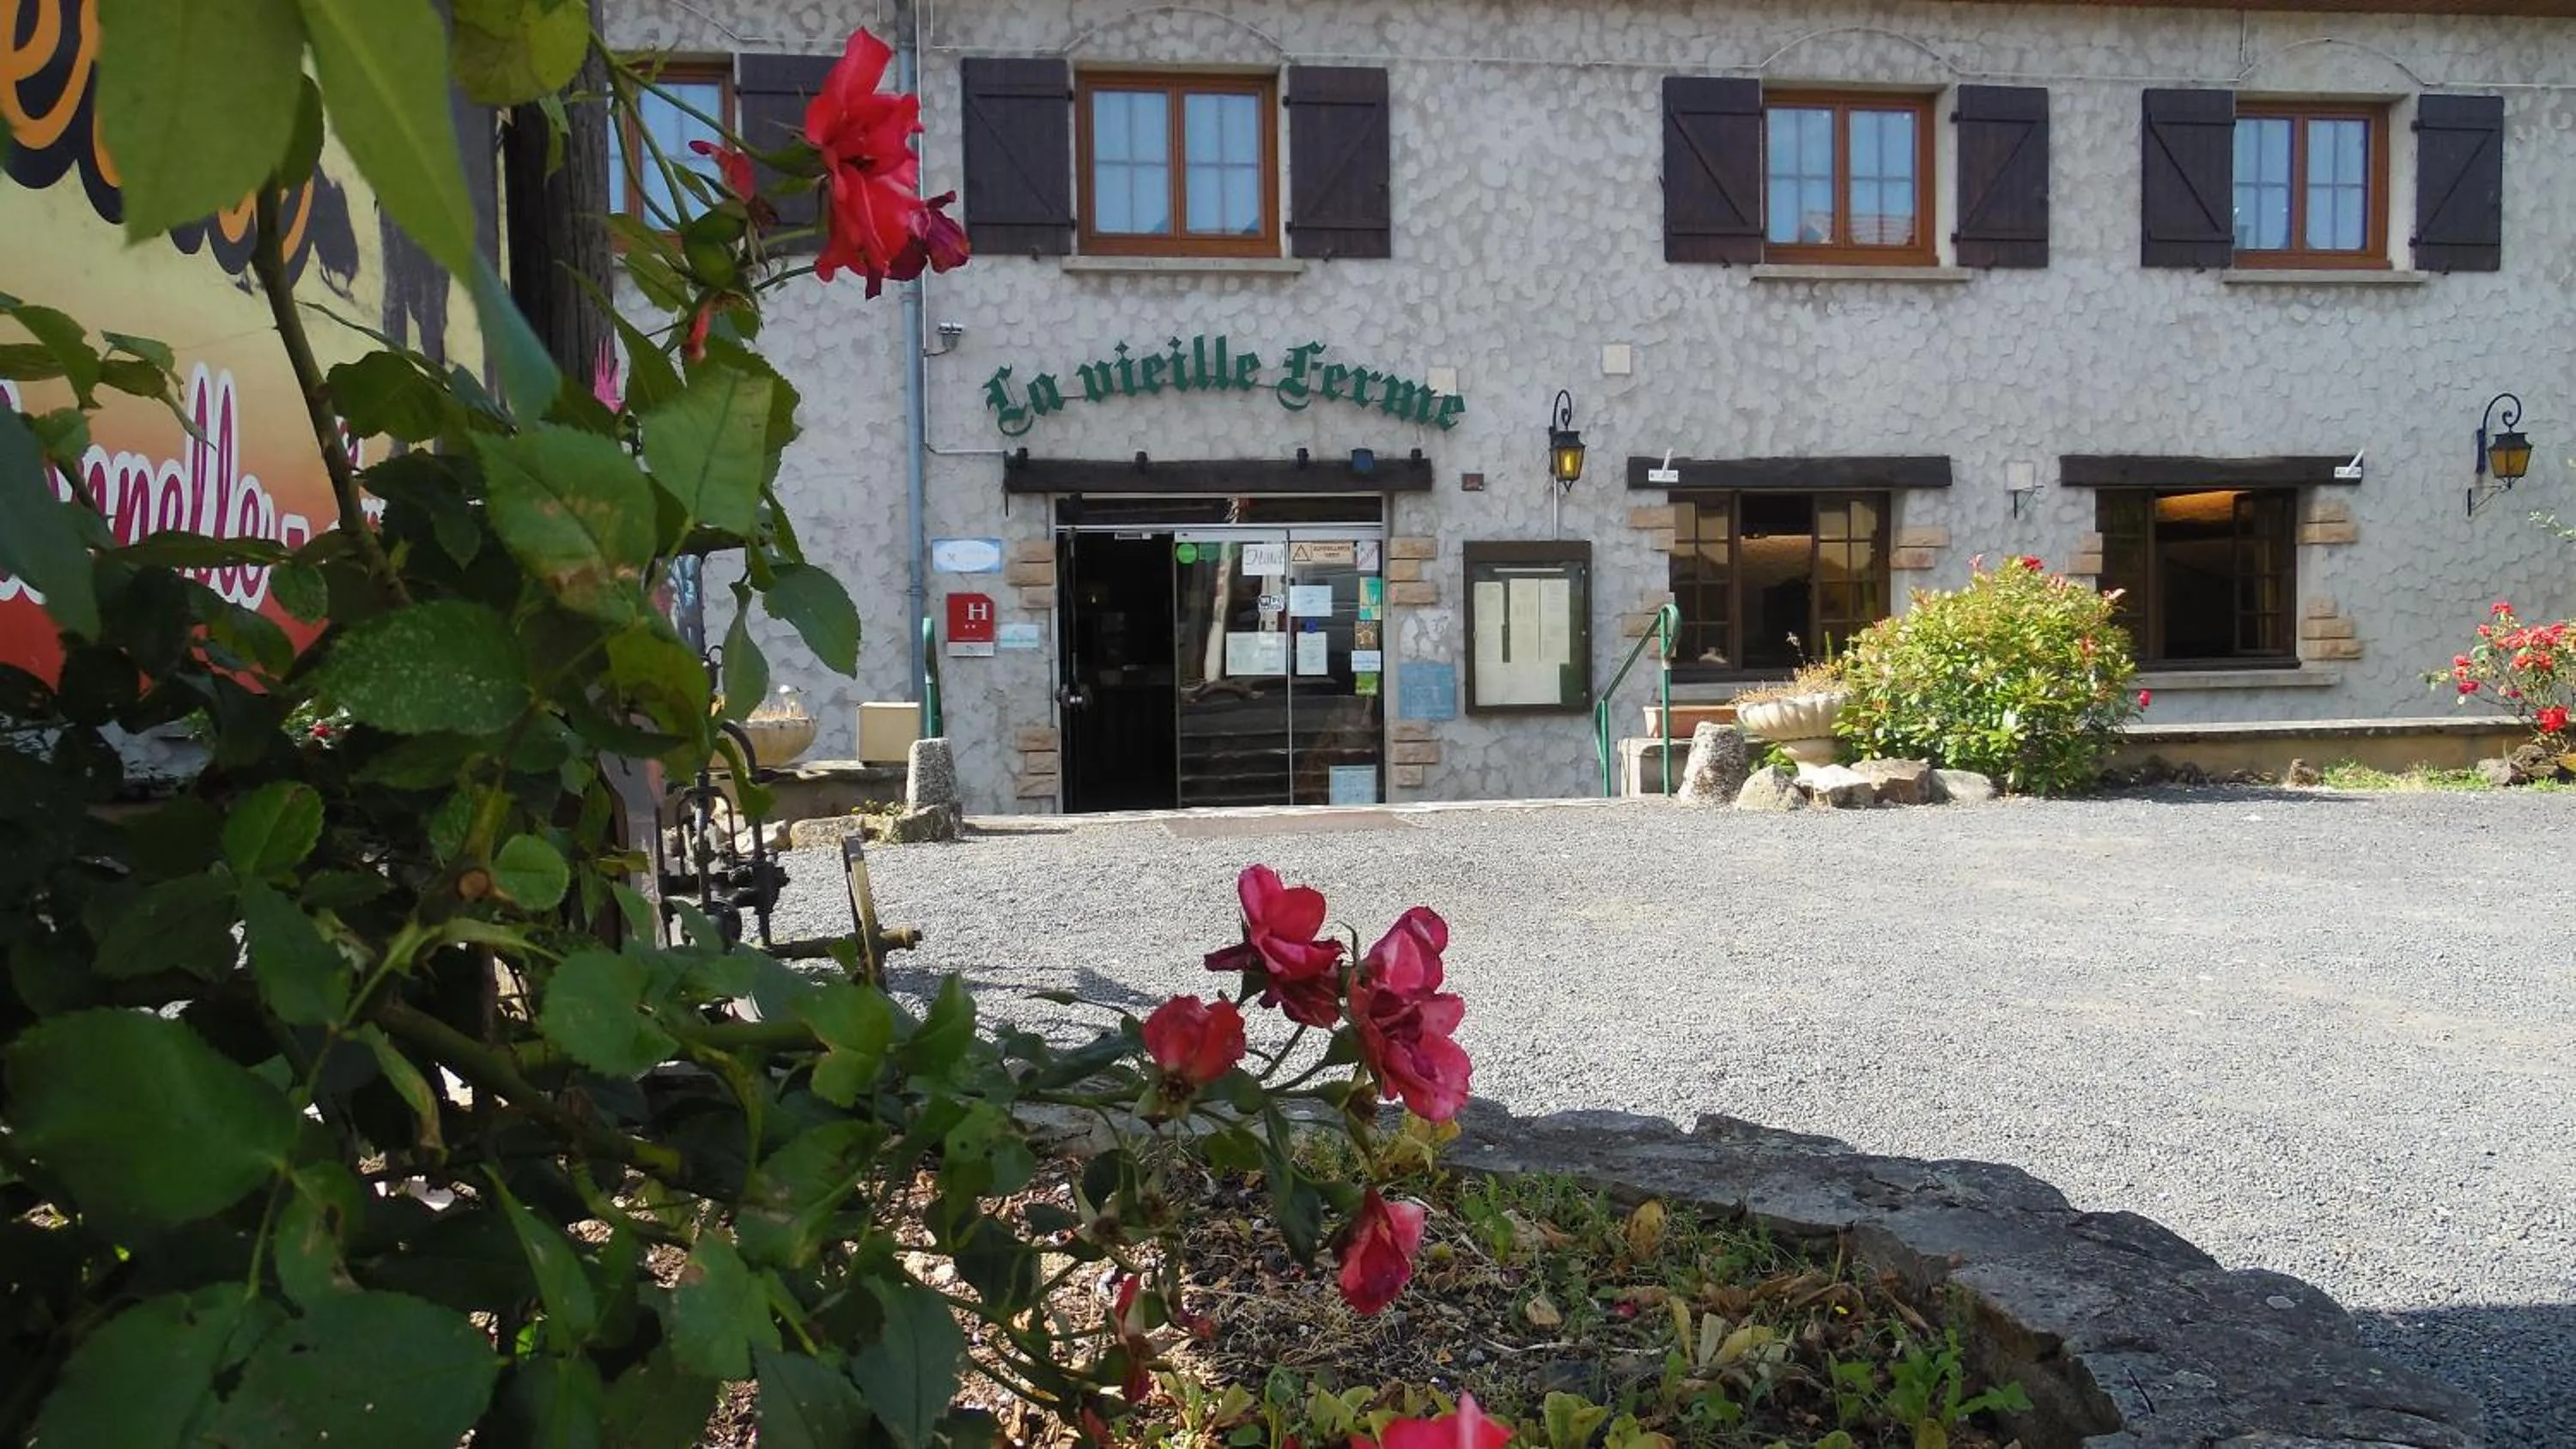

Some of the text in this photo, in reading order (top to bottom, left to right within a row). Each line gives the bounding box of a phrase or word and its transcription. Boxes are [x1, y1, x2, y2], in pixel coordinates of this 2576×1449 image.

[983, 334, 1466, 436] La vieille Ferme
[968, 603, 988, 621] H
